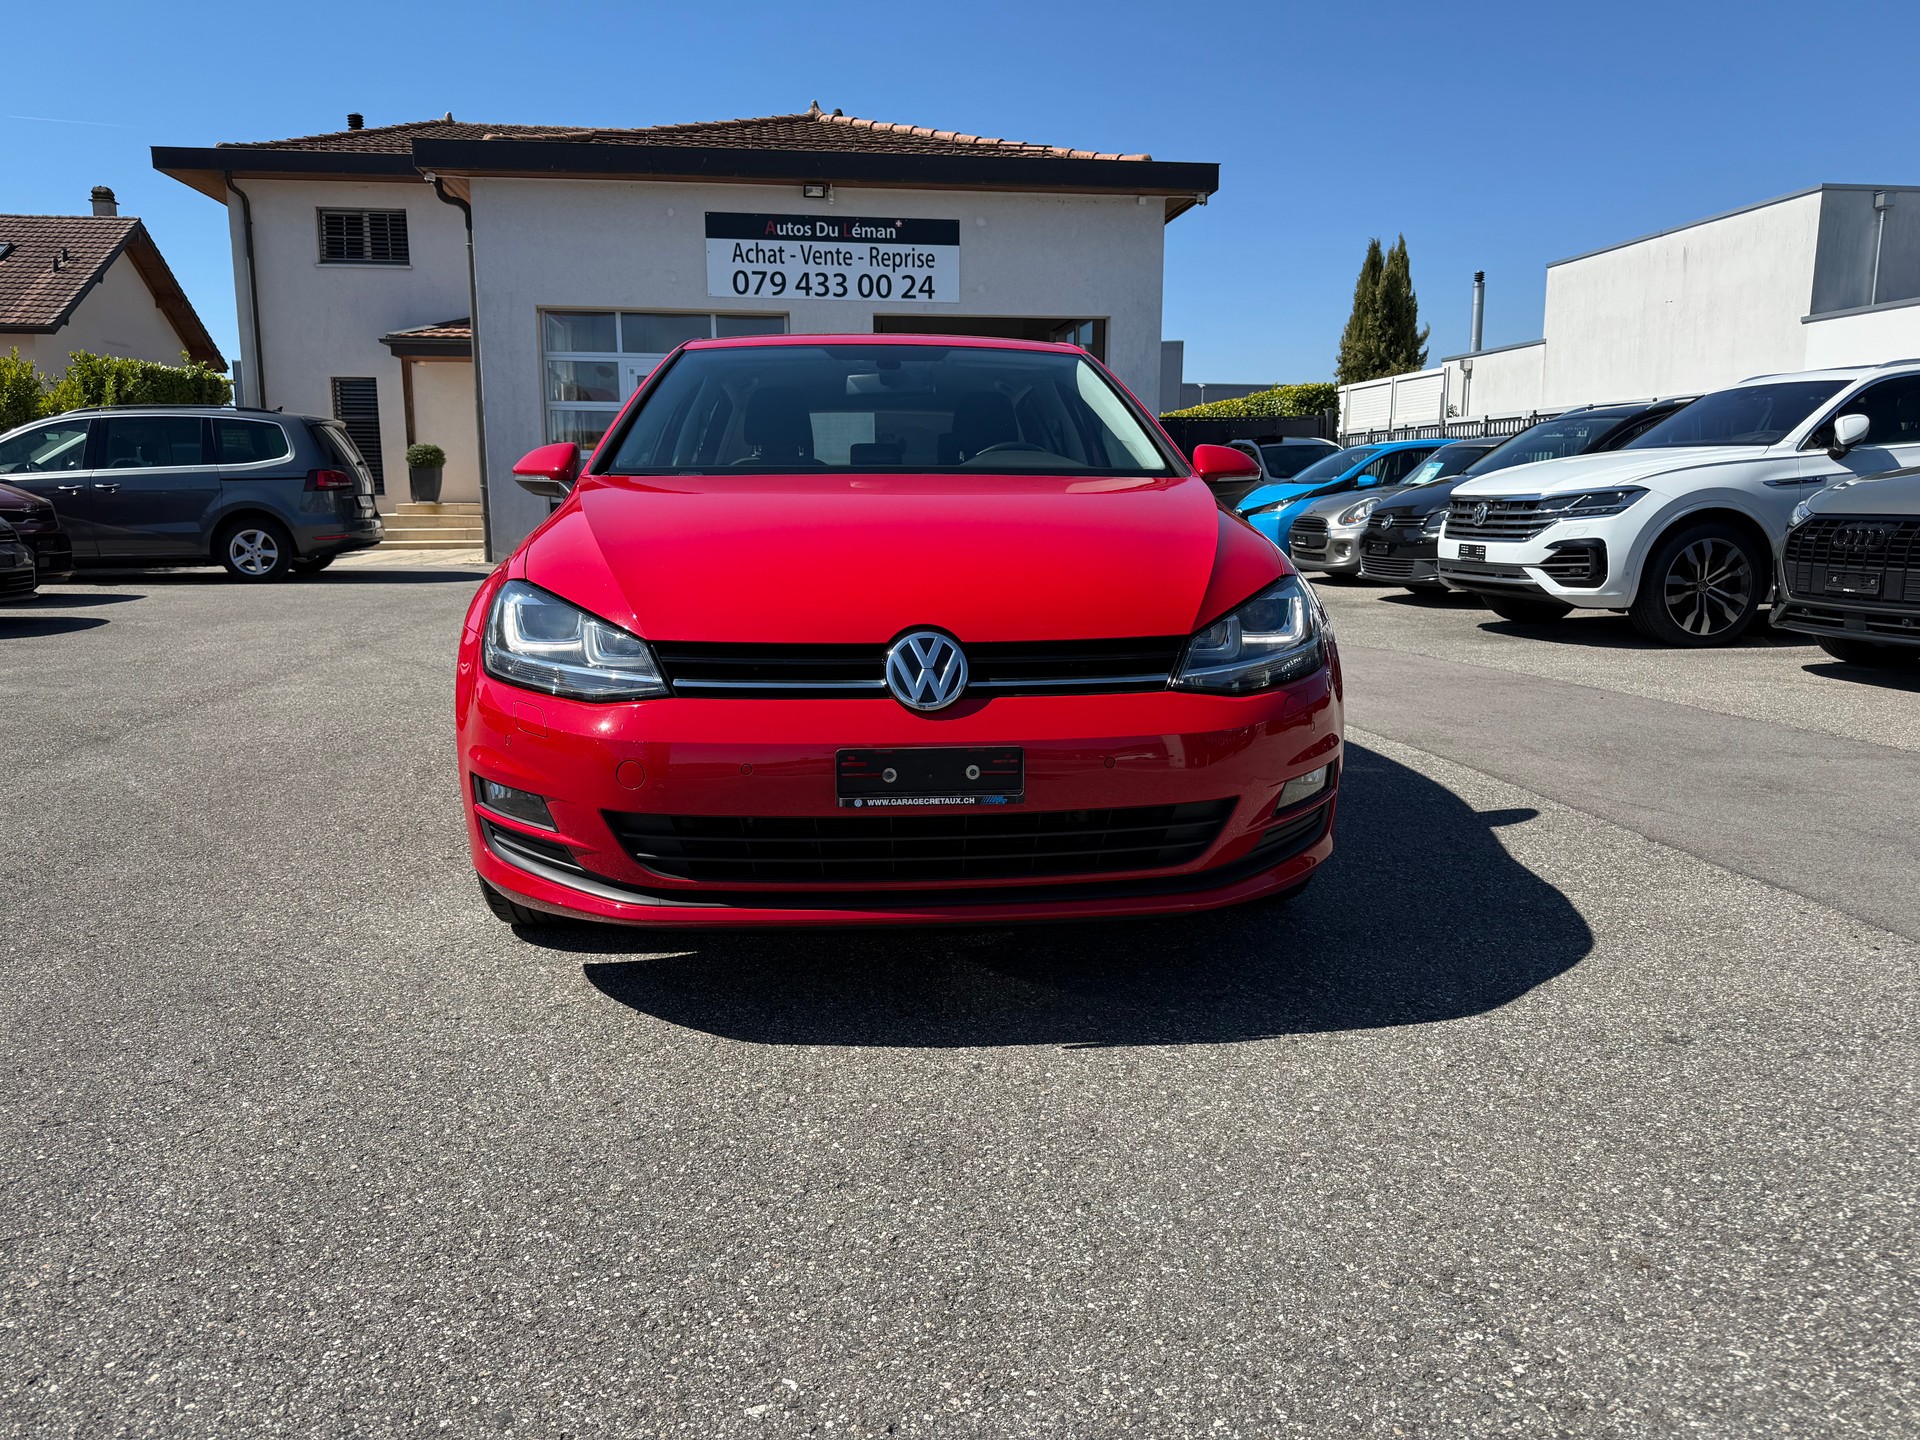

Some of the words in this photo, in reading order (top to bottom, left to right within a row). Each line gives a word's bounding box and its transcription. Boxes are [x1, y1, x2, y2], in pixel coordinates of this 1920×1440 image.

[765, 220, 812, 237] Autos
[815, 221, 839, 237] Du
[843, 223, 896, 239] Léman
[732, 242, 785, 264] Achat
[800, 244, 853, 266] Vente
[869, 246, 936, 273] Reprise
[732, 269, 787, 295] 079
[795, 271, 848, 297] 433
[857, 273, 892, 299] 00
[900, 275, 936, 300] 24
[887, 633, 967, 708] VW
[867, 797, 976, 806] WWW.GARAGECRETAUX.CH
